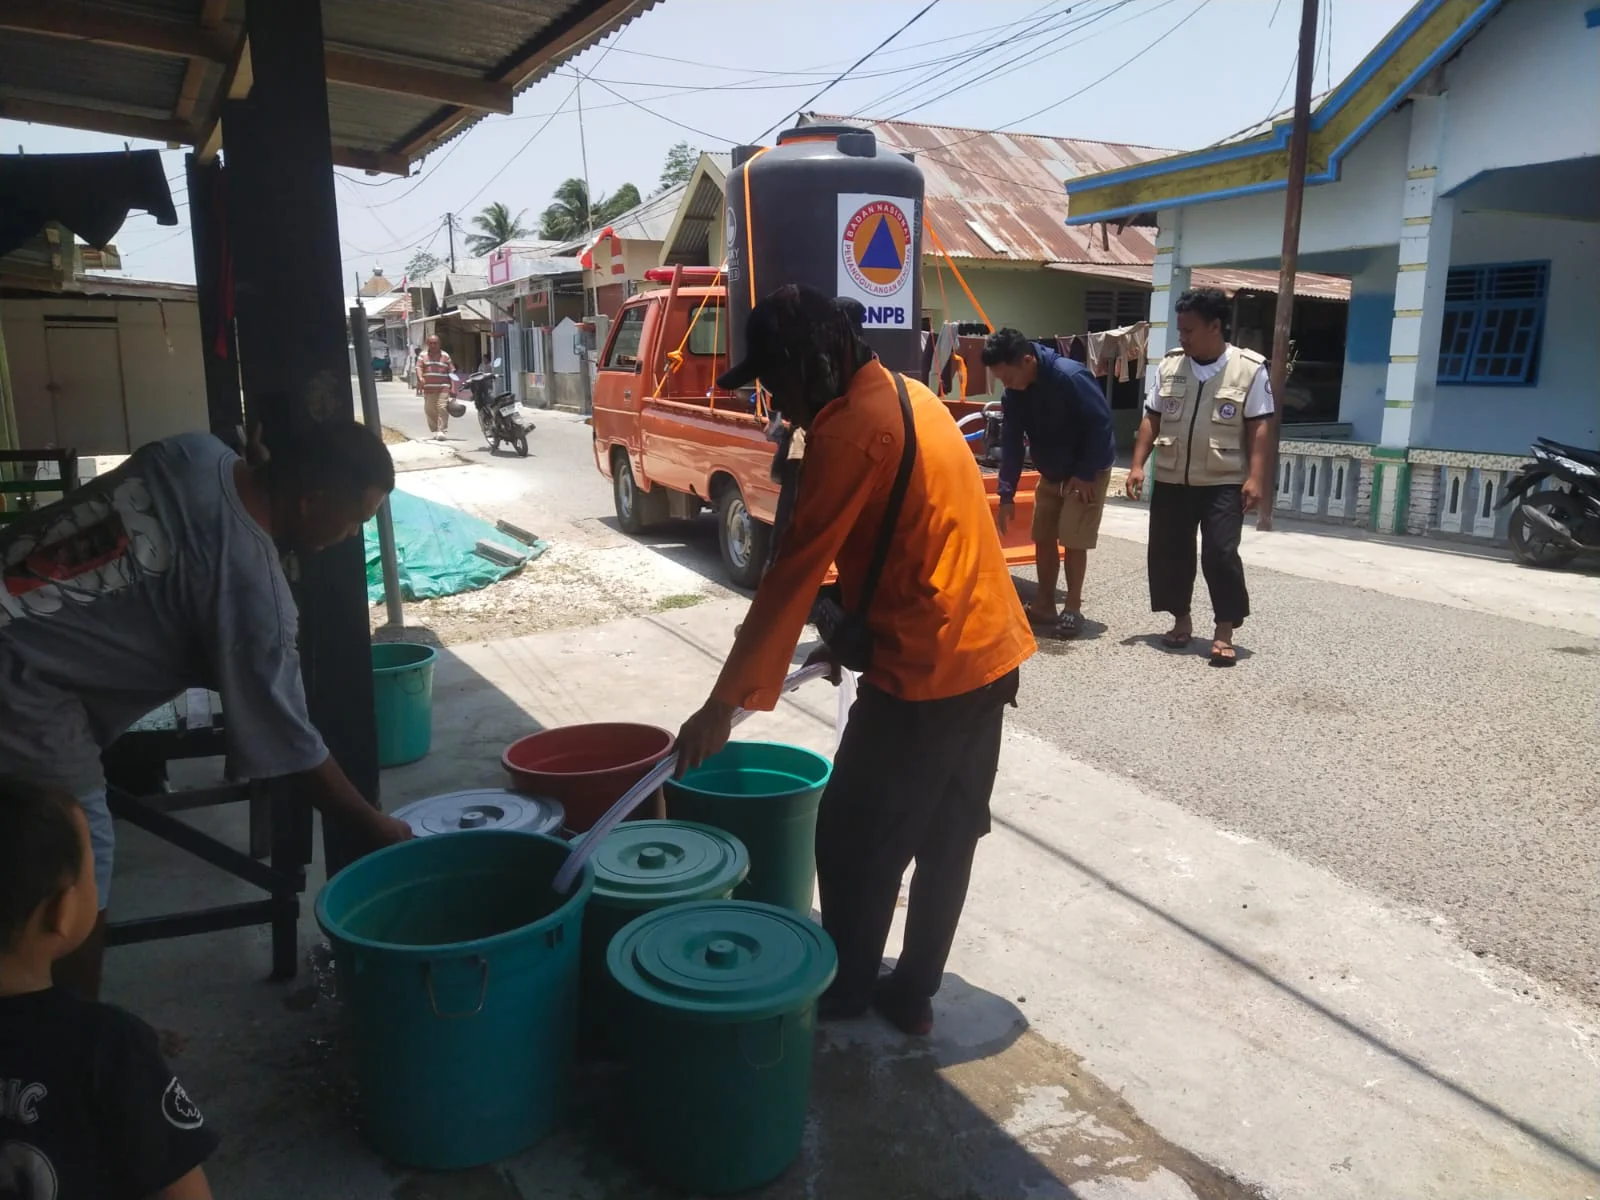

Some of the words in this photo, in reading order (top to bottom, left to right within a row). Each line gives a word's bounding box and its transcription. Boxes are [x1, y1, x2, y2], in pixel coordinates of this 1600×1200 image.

[846, 206, 874, 238] BADAN
[876, 203, 910, 241] NASIONAL
[844, 243, 898, 295] PENANGGULANGAN
